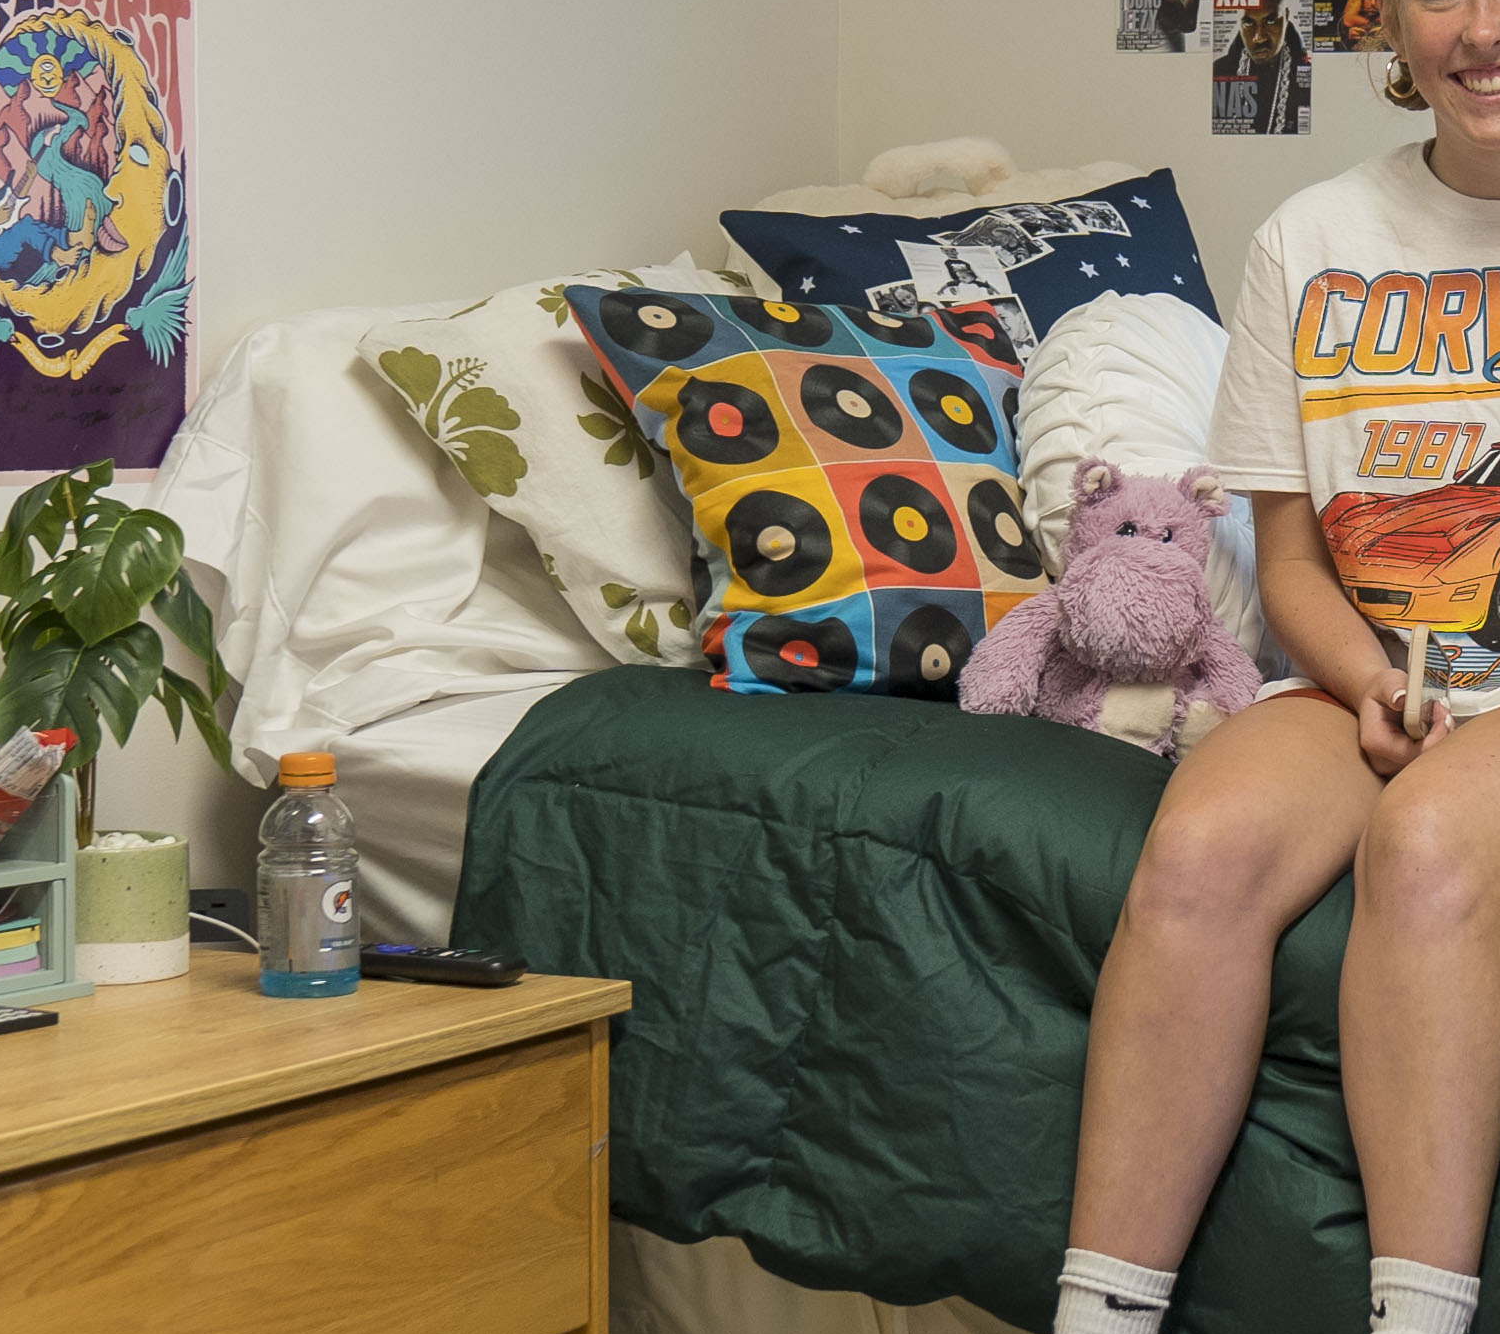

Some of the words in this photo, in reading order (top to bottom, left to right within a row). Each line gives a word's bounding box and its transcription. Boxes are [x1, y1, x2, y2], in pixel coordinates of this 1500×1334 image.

[1119, 10, 1158, 34] JEEZY
[1213, 80, 1259, 118] NAS
[1358, 419, 1486, 480] 1981
